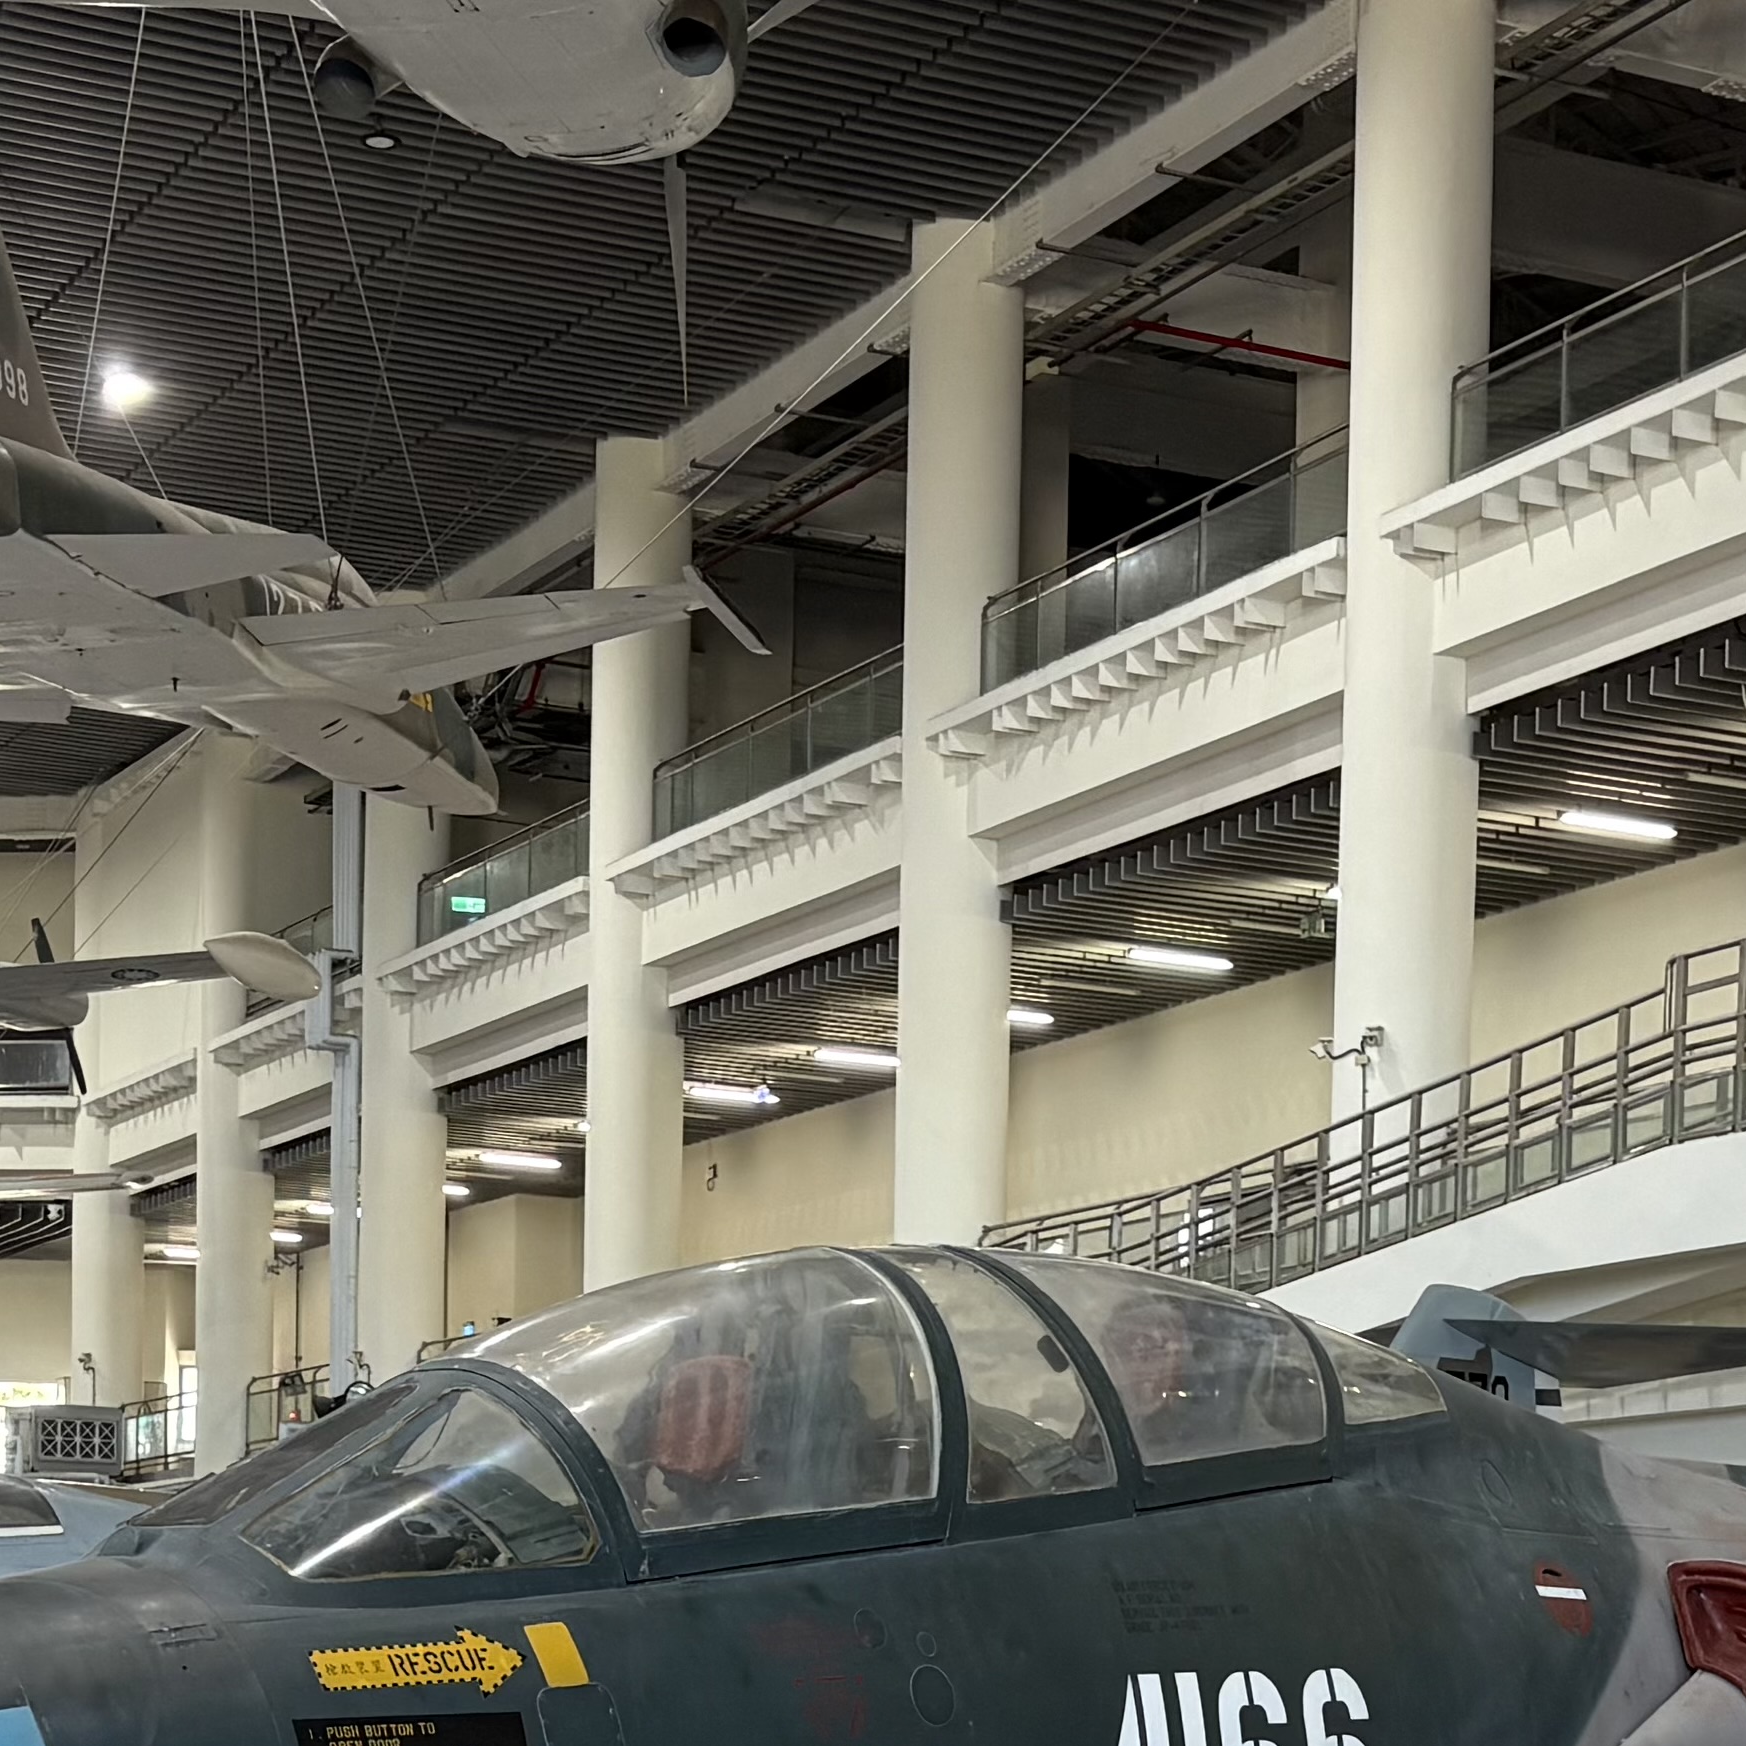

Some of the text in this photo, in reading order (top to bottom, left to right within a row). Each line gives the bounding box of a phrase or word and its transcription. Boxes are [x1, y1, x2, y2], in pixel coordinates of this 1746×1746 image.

[388, 1649, 495, 1677] RESCUE
[326, 1725, 360, 1739] PUSH
[364, 1723, 414, 1737] BUTTON
[418, 1722, 436, 1735] TO
